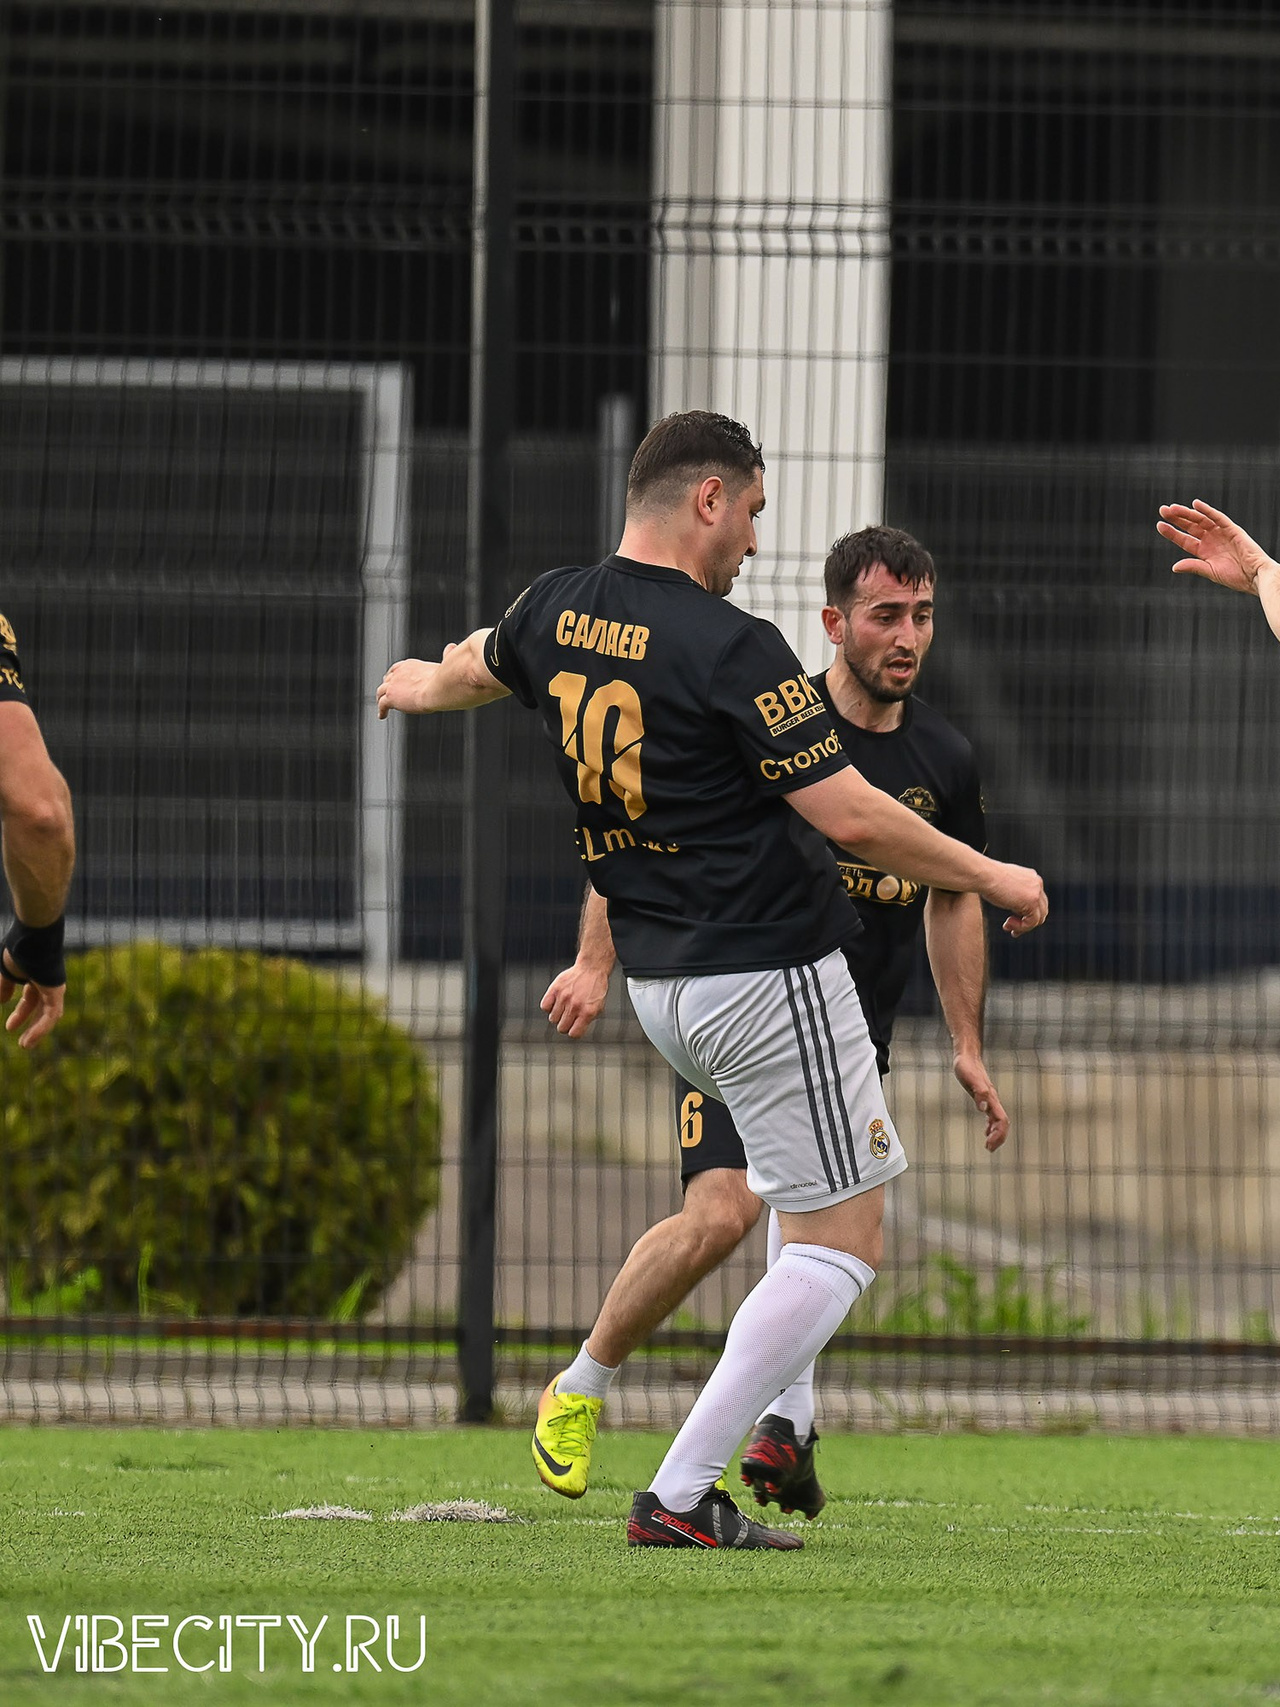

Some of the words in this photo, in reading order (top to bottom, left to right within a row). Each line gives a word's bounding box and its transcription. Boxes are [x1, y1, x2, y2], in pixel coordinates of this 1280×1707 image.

[556, 609, 650, 661] САЛАЕВ
[772, 716, 801, 735] BURGER
[548, 670, 647, 820] 10
[838, 866, 864, 878] СЕТЬ
